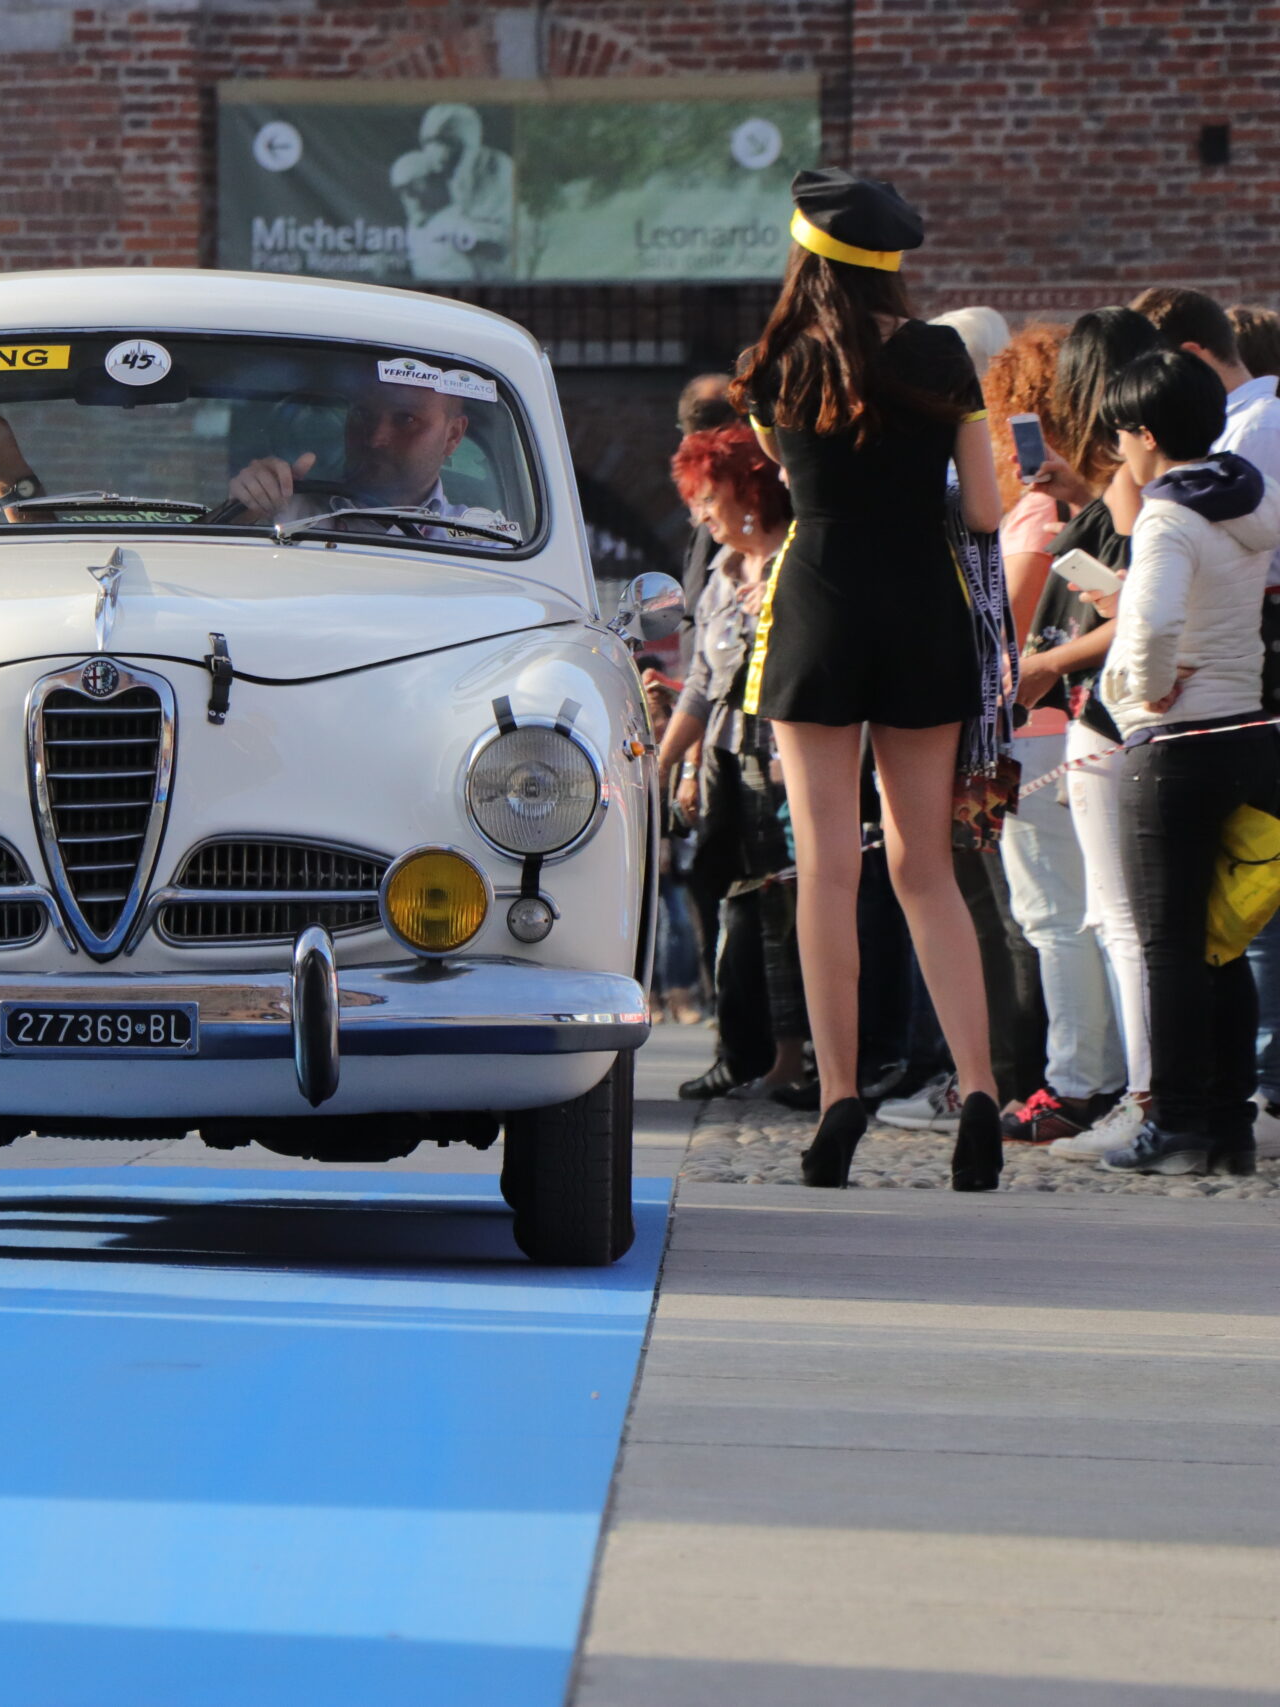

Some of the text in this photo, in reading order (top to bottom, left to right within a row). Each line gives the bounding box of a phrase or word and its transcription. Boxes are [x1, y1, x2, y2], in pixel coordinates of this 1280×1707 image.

[634, 216, 782, 250] Leonardo
[122, 354, 156, 370] 45
[384, 368, 439, 381] VERIFICATO
[442, 379, 494, 394] ERIFICATO
[17, 1012, 186, 1043] 277369 BL
